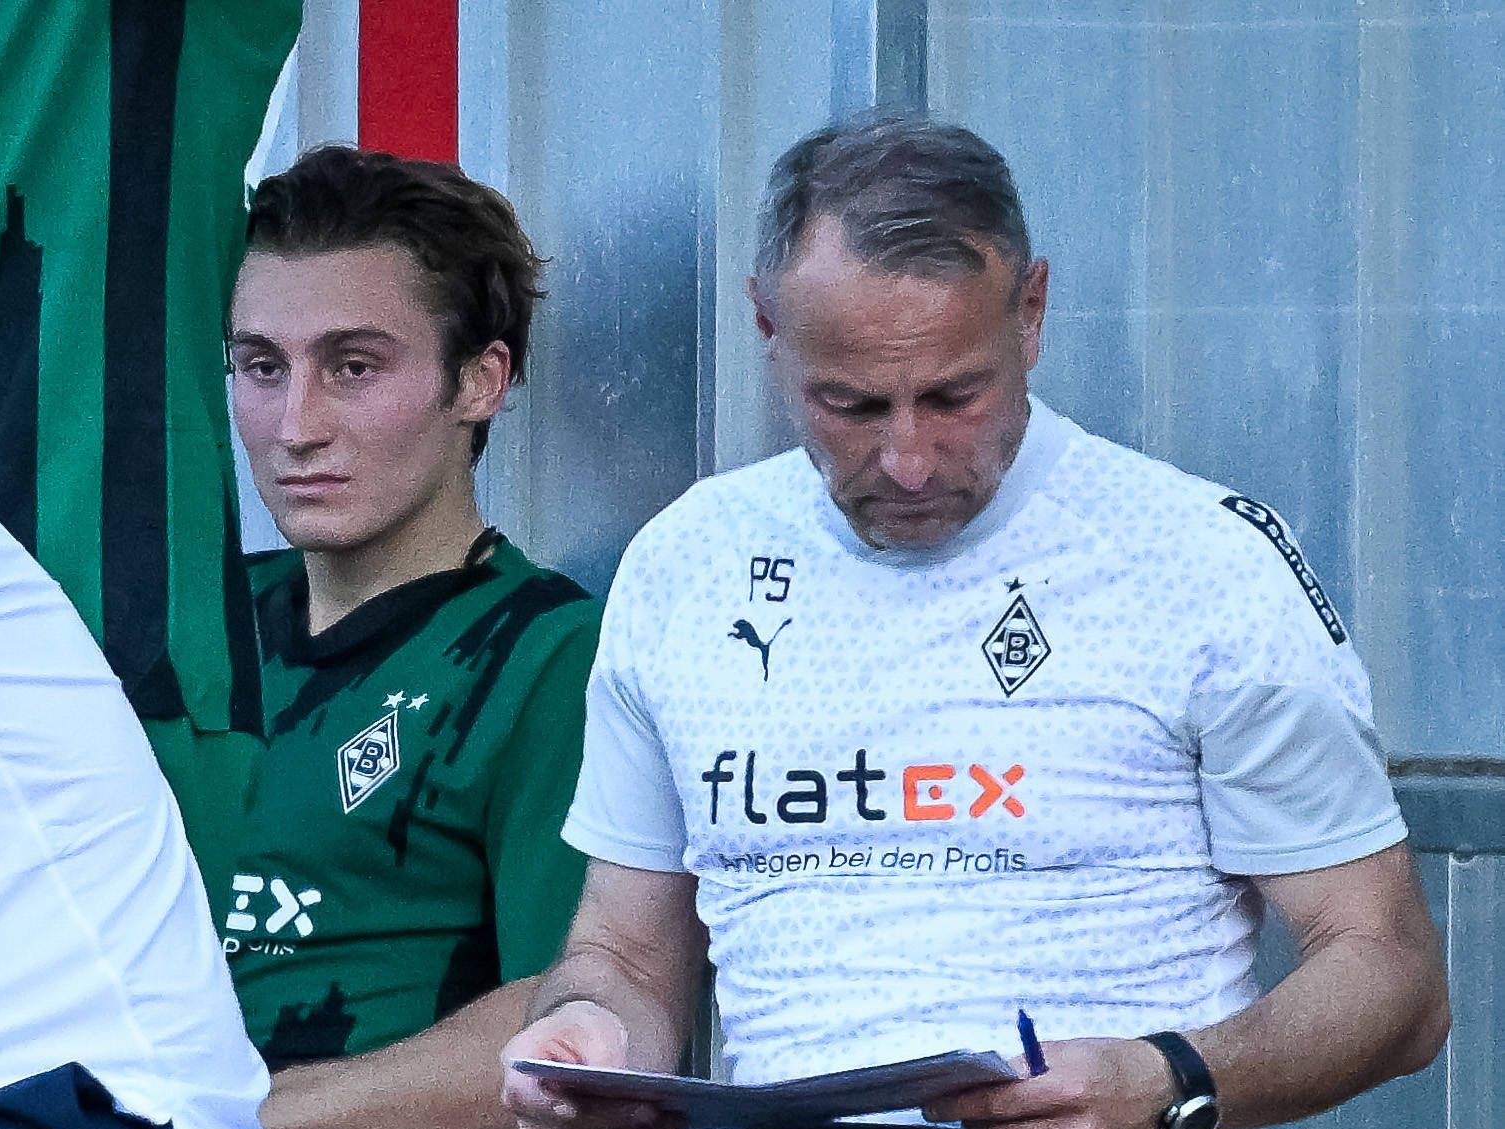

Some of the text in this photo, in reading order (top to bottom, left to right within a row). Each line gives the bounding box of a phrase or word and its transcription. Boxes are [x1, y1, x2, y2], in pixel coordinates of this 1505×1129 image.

[749, 556, 795, 603] PS
[828, 845, 873, 869] bei
[880, 845, 935, 872] den
[944, 847, 1027, 874] Profis
